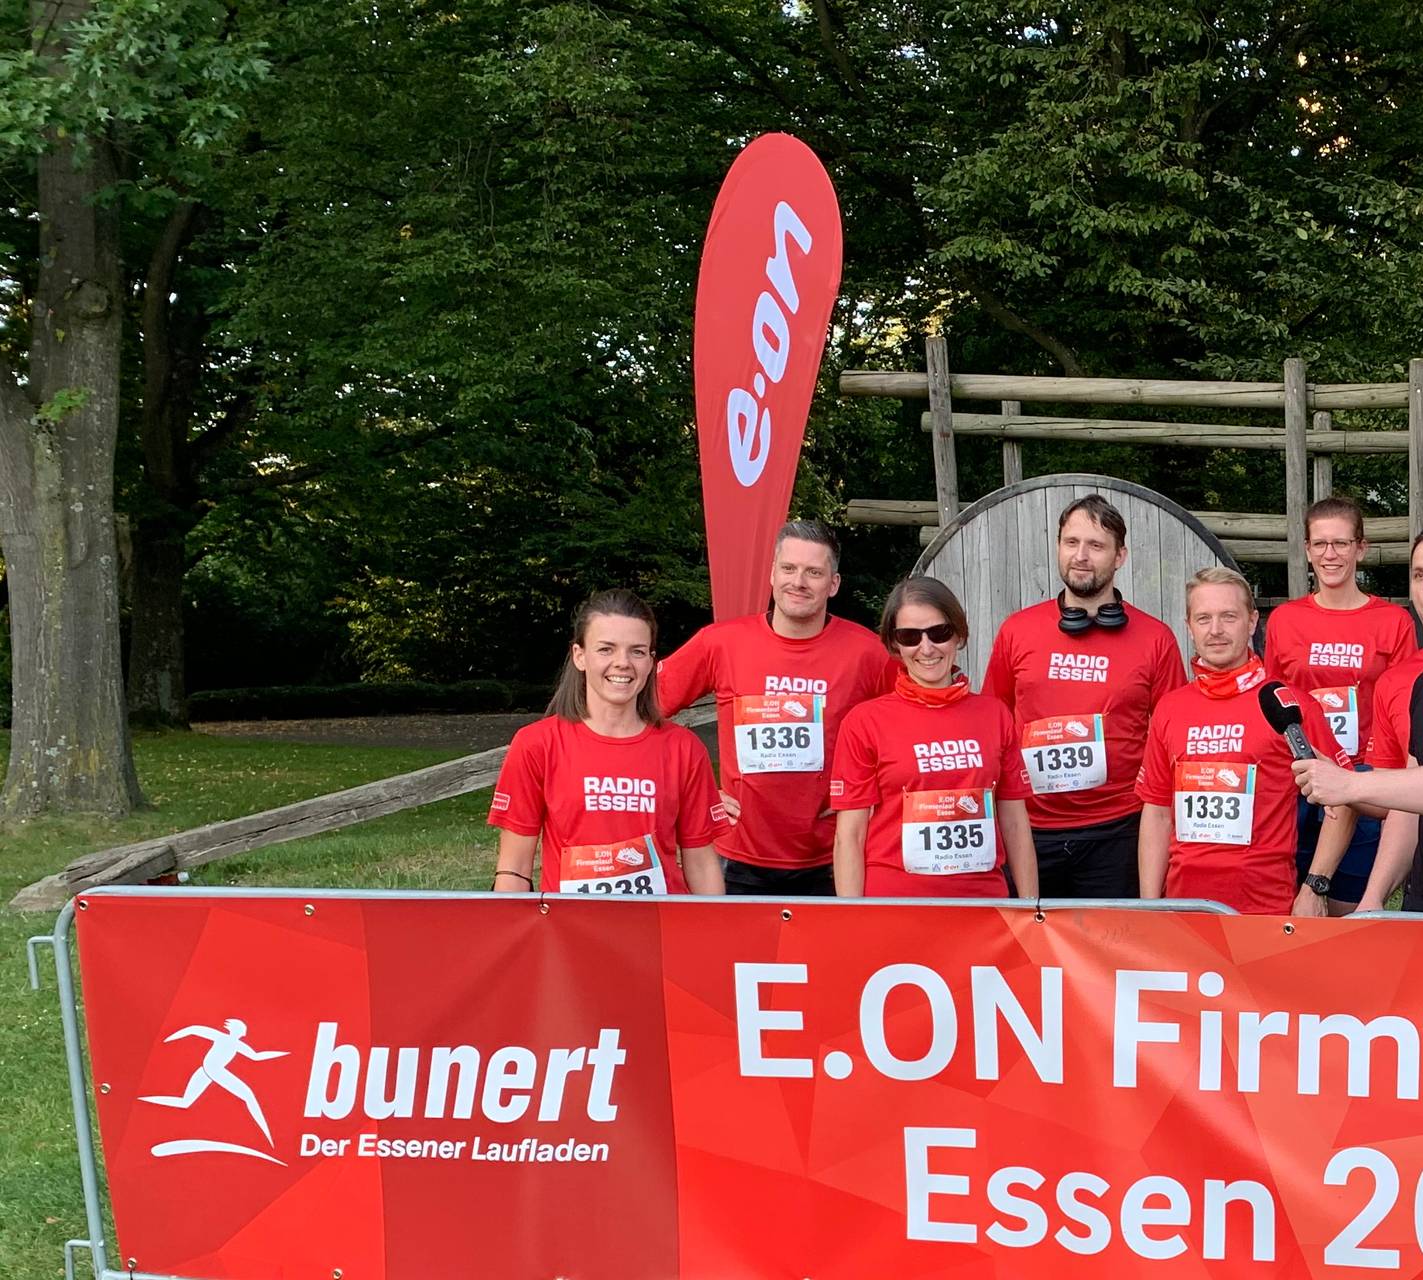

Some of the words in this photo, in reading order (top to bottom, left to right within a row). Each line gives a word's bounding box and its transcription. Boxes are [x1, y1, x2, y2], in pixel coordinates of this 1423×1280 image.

[1310, 643, 1364, 655] RADIO
[1050, 652, 1109, 668] RADIO
[1308, 654, 1363, 669] ESSEN
[1048, 667, 1108, 683] ESSEN
[765, 676, 828, 694] RADIO
[747, 726, 811, 750] 1336
[1187, 724, 1245, 738] RADIO
[913, 739, 981, 758] RADIO
[1186, 738, 1243, 755] ESSEN
[917, 755, 984, 774] ESSEN
[1033, 745, 1094, 772] 1339
[583, 776, 656, 796] RADIO
[584, 795, 656, 814] ESSEN
[1184, 795, 1241, 820] 1333
[918, 823, 984, 851] 1335
[734, 962, 1064, 1085] E.ON
[303, 1021, 627, 1123] bunert
[299, 1133, 351, 1157] Der
[357, 1133, 467, 1160] Essener
[471, 1136, 610, 1163] Laufladen
[904, 1126, 1276, 1262] Essen
